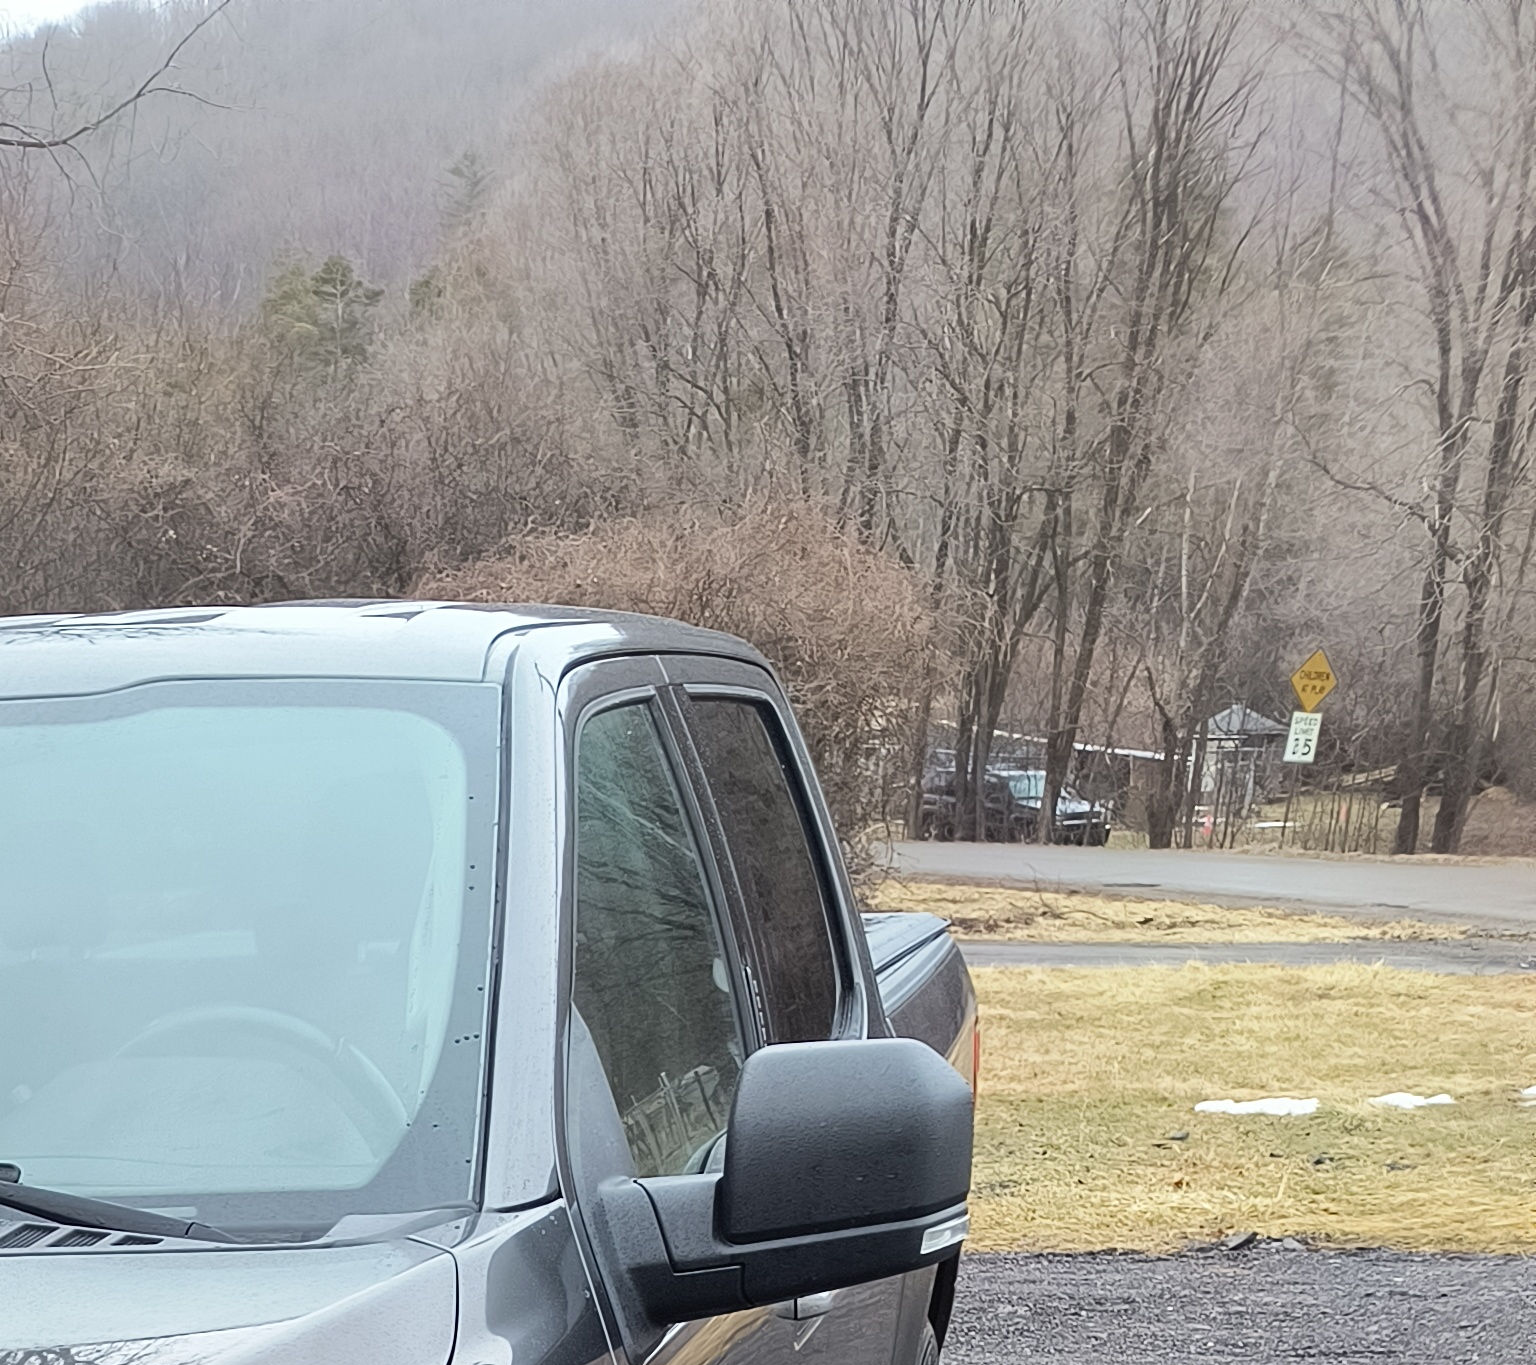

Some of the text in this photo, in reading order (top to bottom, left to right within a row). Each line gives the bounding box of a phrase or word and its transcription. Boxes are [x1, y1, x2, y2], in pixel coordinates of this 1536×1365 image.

[1299, 670, 1330, 681] CHILDREN
[1294, 716, 1318, 726] SPEED
[1294, 728, 1315, 736] LIMIT
